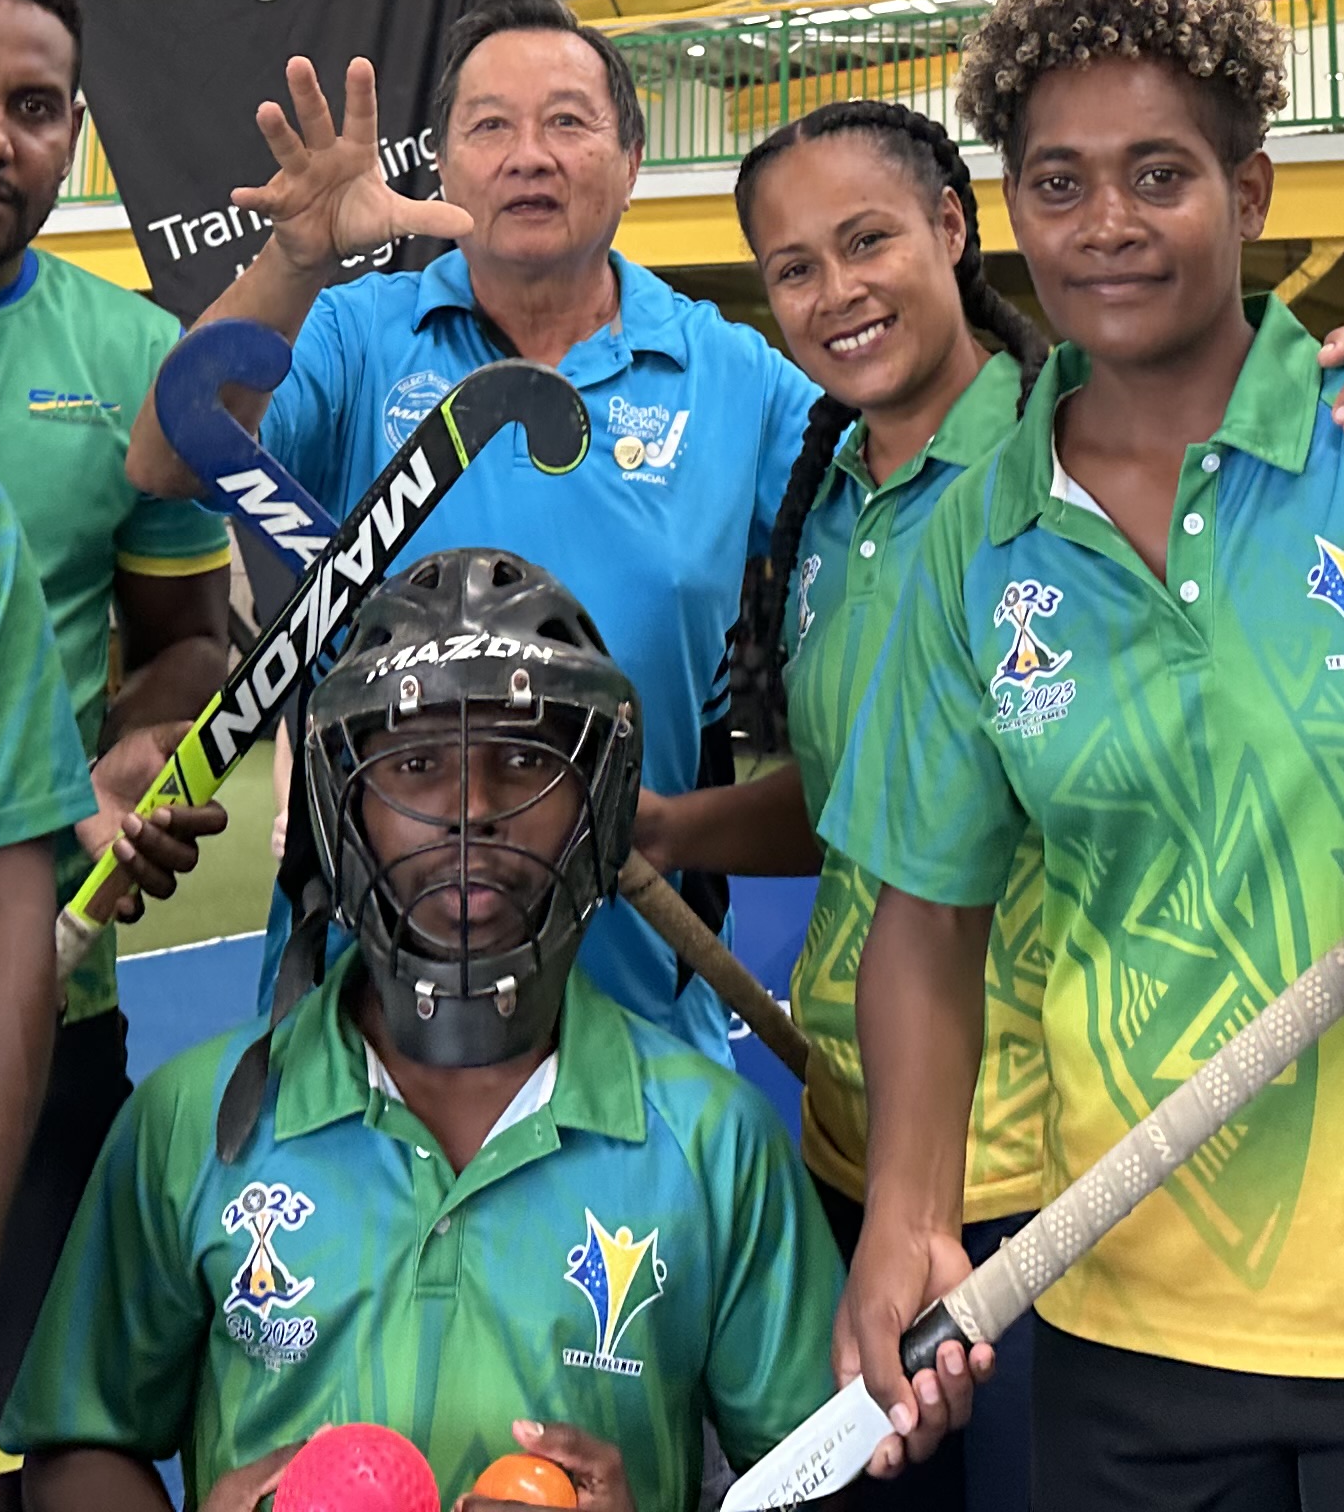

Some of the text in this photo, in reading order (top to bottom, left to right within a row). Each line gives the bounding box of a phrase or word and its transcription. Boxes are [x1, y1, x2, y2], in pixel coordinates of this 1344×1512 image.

[608, 395, 670, 422] Oceania
[608, 408, 667, 437] Hockey
[621, 471, 668, 486] OFFICIAL
[210, 445, 437, 768] MAZON
[996, 584, 1059, 620] 2023
[365, 630, 554, 685] MAZON
[1019, 681, 1075, 714] 2023
[996, 708, 1067, 732] PACIFIC GAMES
[225, 1189, 309, 1228] 2023
[260, 1319, 316, 1347] 2023
[564, 1350, 642, 1374] TEAM SOLOMON
